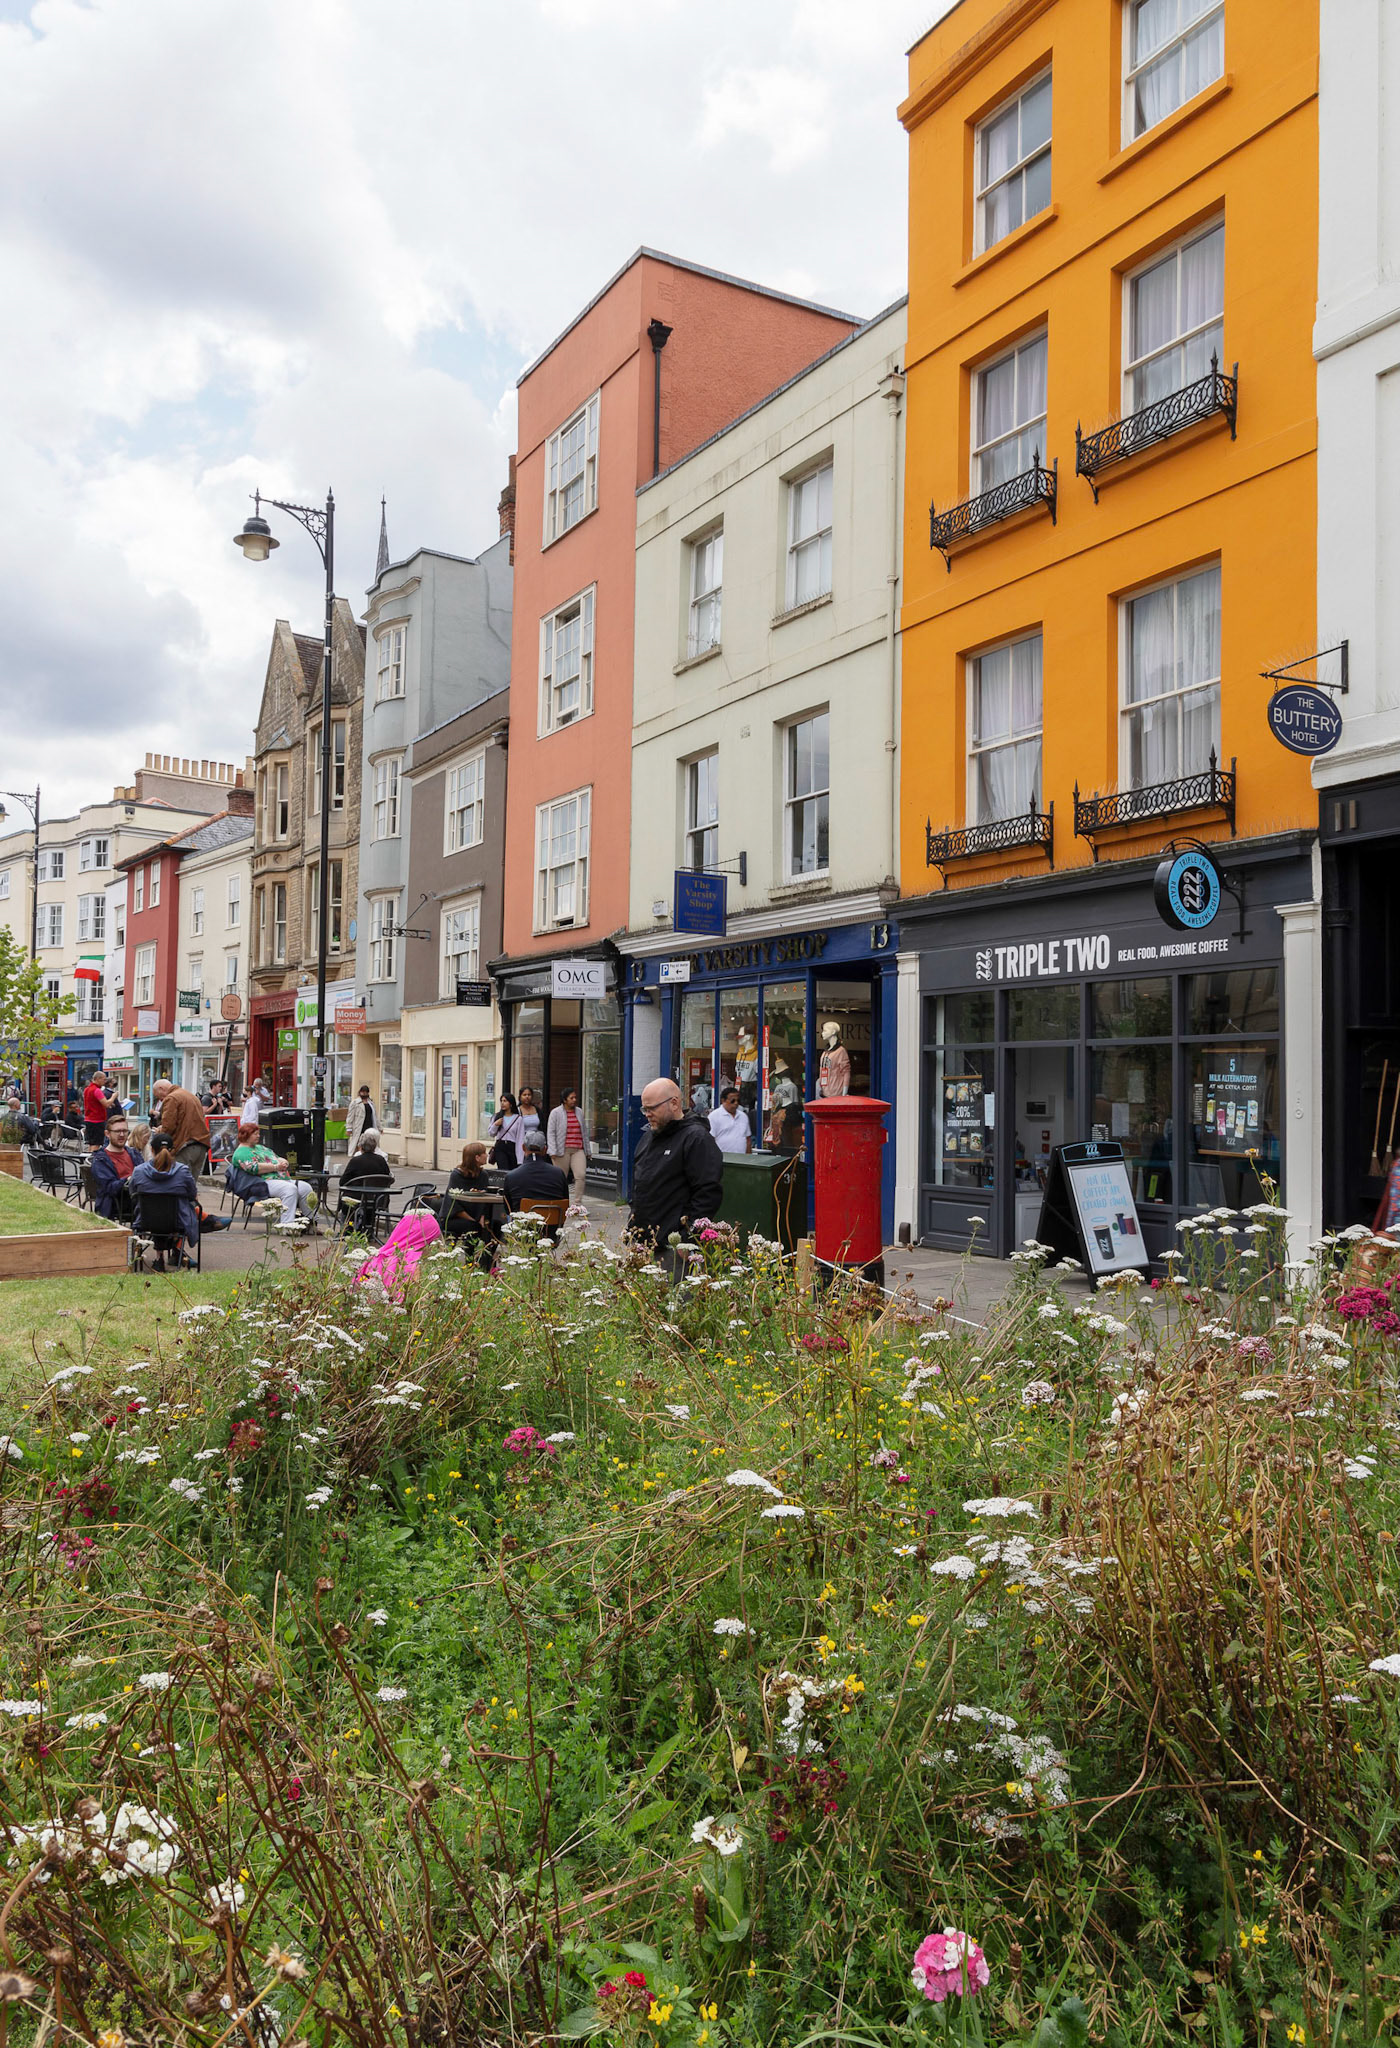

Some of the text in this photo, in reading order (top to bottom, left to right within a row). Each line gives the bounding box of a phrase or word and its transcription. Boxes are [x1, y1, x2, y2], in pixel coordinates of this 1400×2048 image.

[1297, 697, 1314, 709] THE
[1273, 707, 1340, 733] BUTTERY
[1291, 730, 1320, 745] HOTEL
[1179, 856, 1210, 871] TRIPLE TWO
[692, 879, 710, 889] The
[685, 888, 717, 899] Varsity
[689, 898, 713, 910] Shop
[1187, 912, 1212, 925] AWESOME
[870, 923, 889, 949] 13
[703, 942, 773, 972] VARSITY
[776, 933, 828, 961] SHOP
[995, 940, 1060, 980] TRIPLE
[1063, 934, 1110, 973] TWO
[1118, 949, 1136, 962] REAL
[1137, 946, 1158, 960] FOOD,
[1159, 943, 1197, 957] AWESOME
[1198, 939, 1229, 954] COFFEE
[557, 969, 600, 984] OMC
[631, 962, 644, 982] 13
[180, 992, 200, 1001] broad
[336, 1010, 364, 1020] Money
[1229, 1058, 1236, 1072] 5
[1221, 1074, 1257, 1083] ALTERNATIVES
[955, 1105, 971, 1118] 20%
[947, 1119, 981, 1127] STUDENT DISCOUNT
